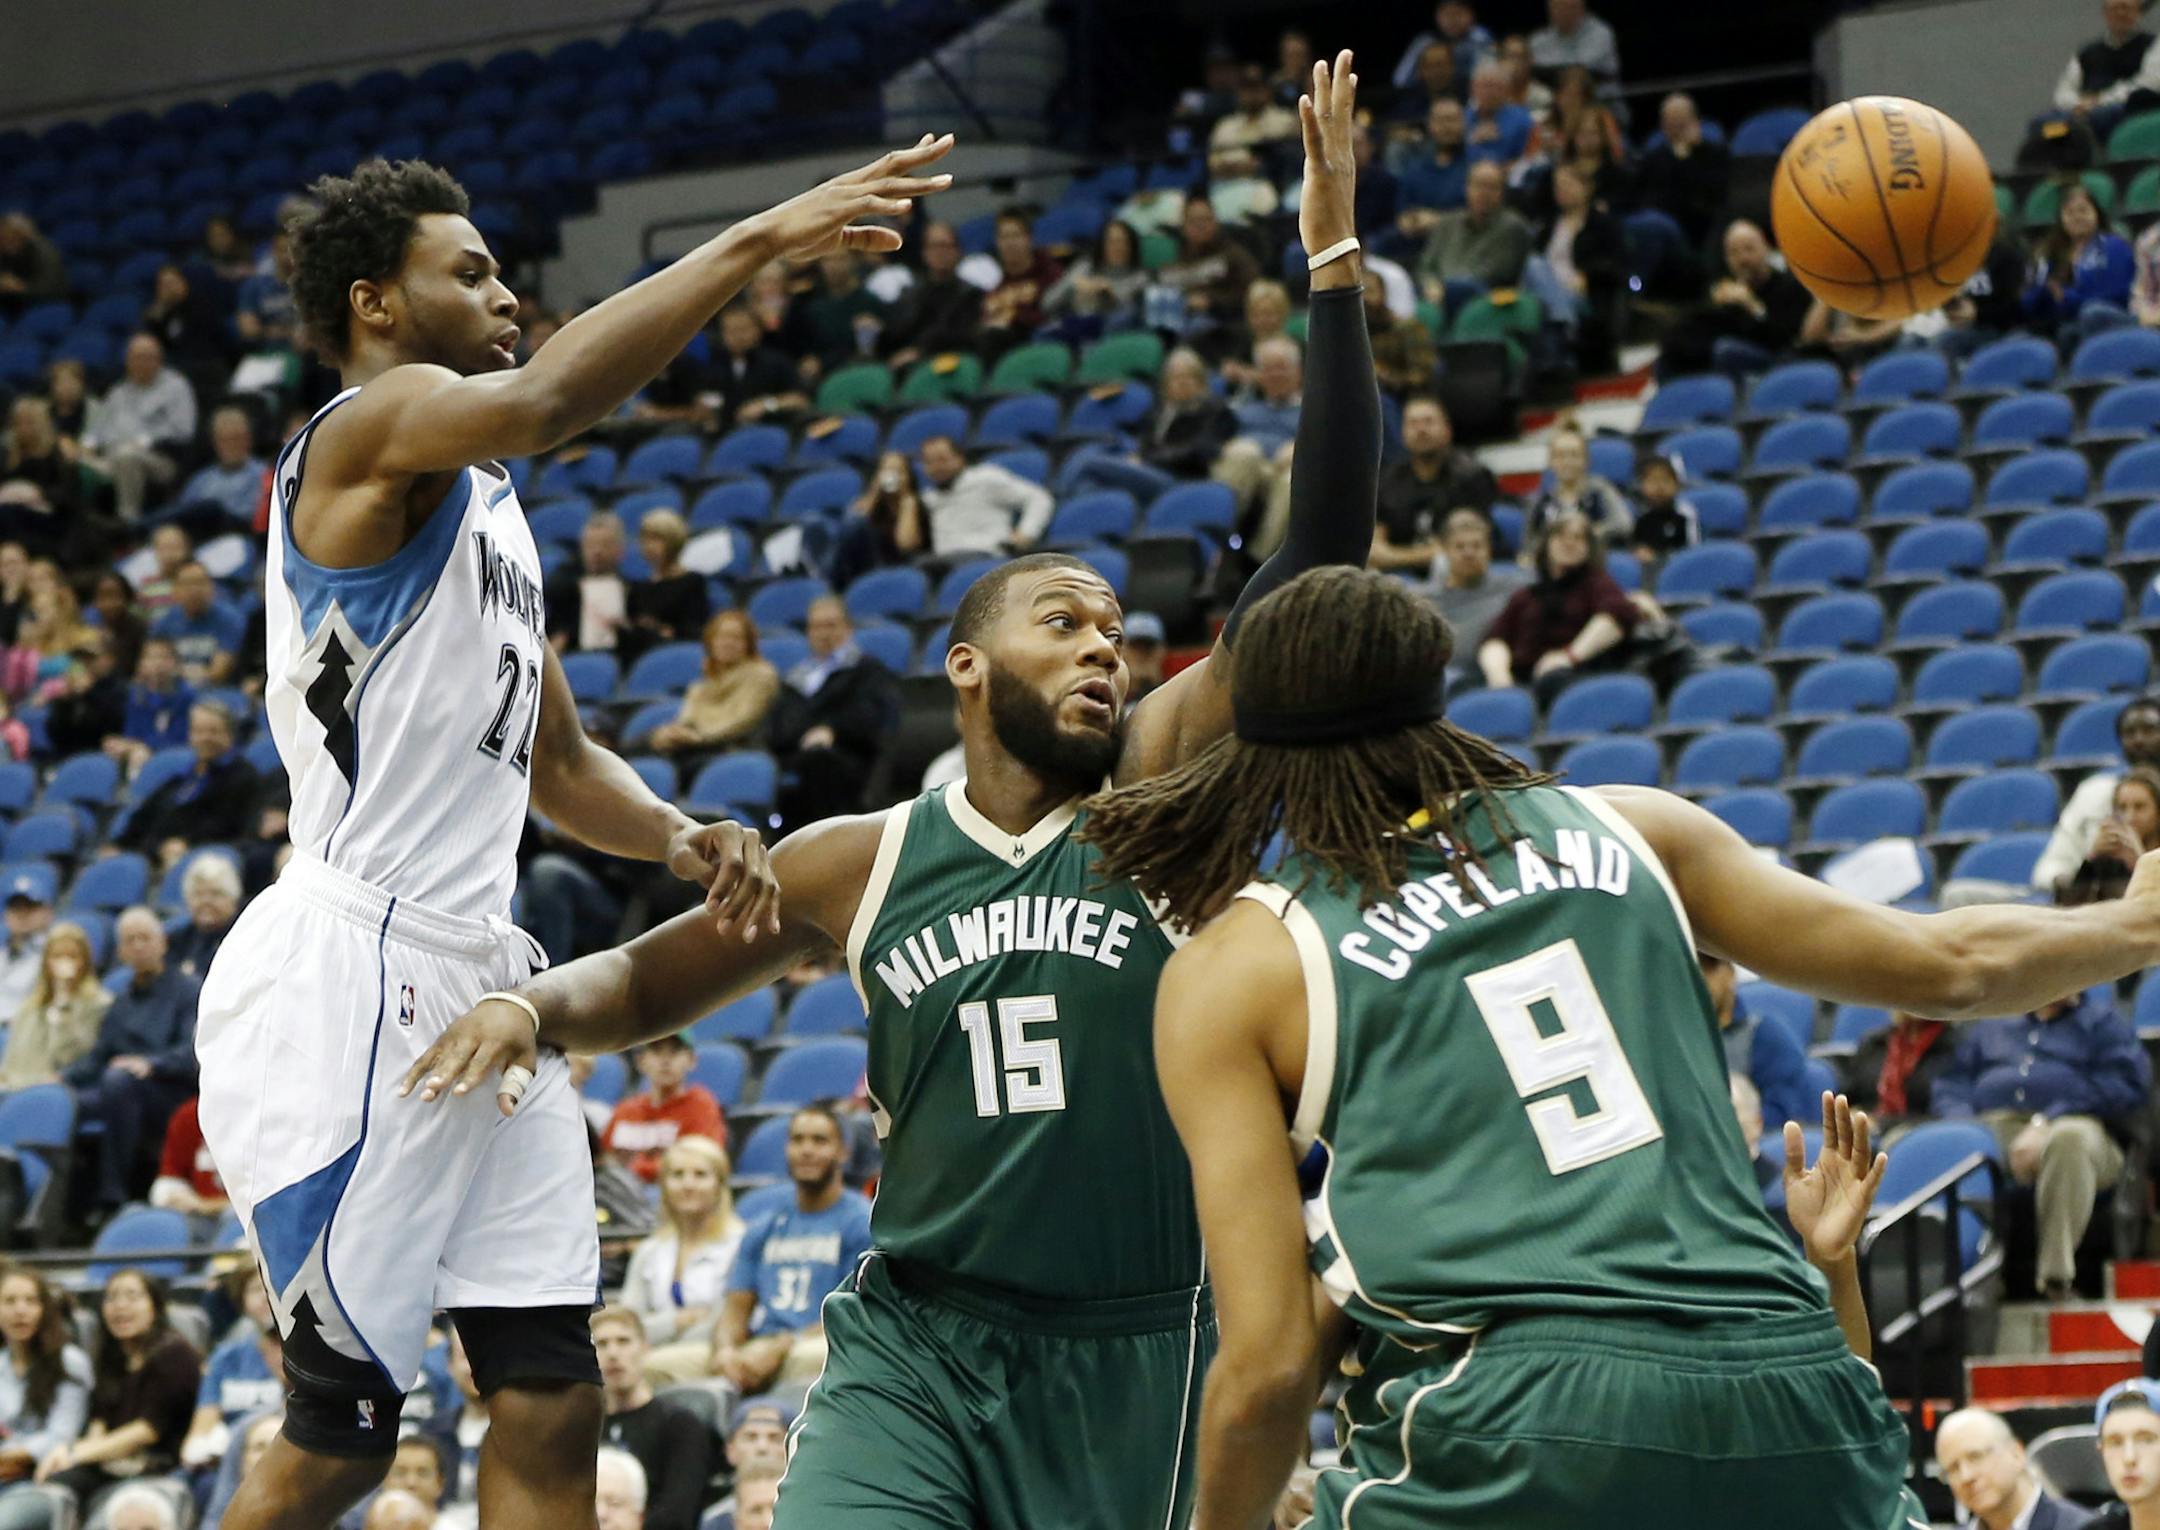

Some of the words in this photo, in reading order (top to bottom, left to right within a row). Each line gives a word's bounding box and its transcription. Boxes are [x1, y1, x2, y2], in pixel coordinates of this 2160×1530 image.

[472, 531, 544, 649] WOLVE
[477, 643, 538, 777] 22
[875, 895, 1138, 1009] MILWAUKEE
[1339, 829, 1630, 980] COPELAND
[958, 994, 1066, 1117] 15
[1464, 938, 1663, 1176] 9
